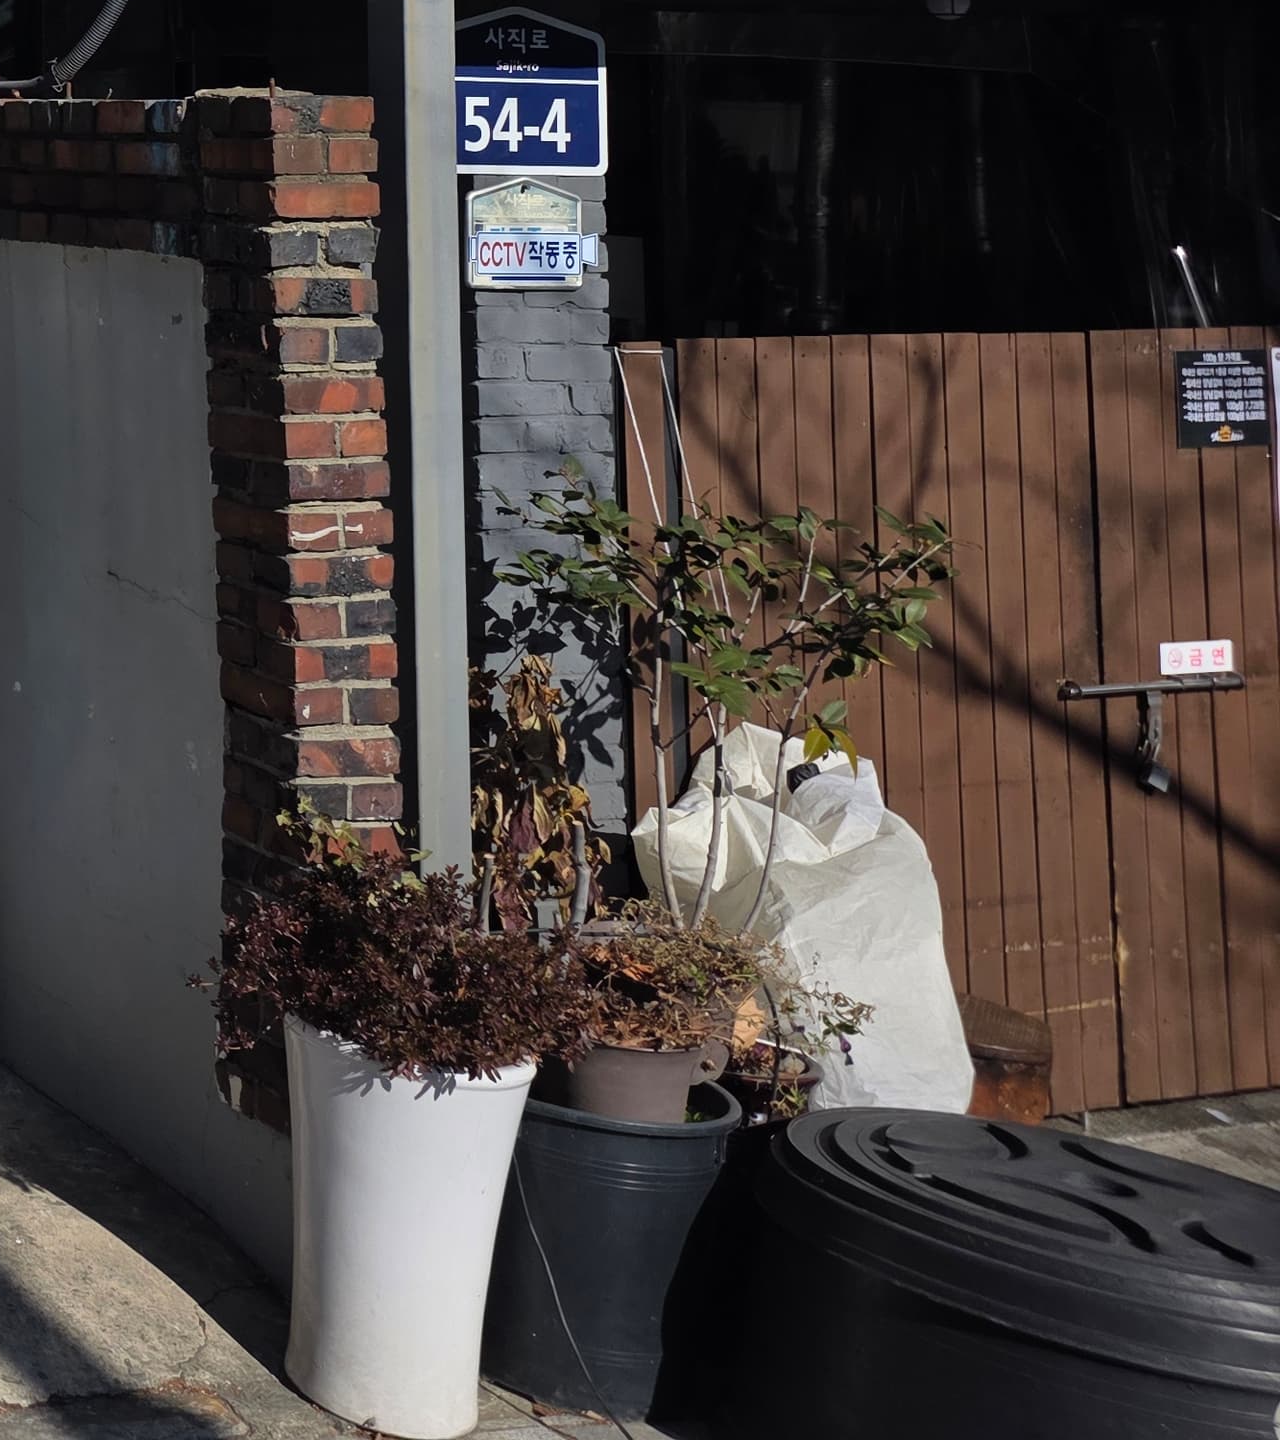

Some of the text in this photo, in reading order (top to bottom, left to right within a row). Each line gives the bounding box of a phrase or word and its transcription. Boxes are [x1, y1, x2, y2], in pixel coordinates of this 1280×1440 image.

[484, 28, 550, 54] 사직로
[496, 59, 540, 73] Sajik-ro
[464, 96, 572, 153] 54-4
